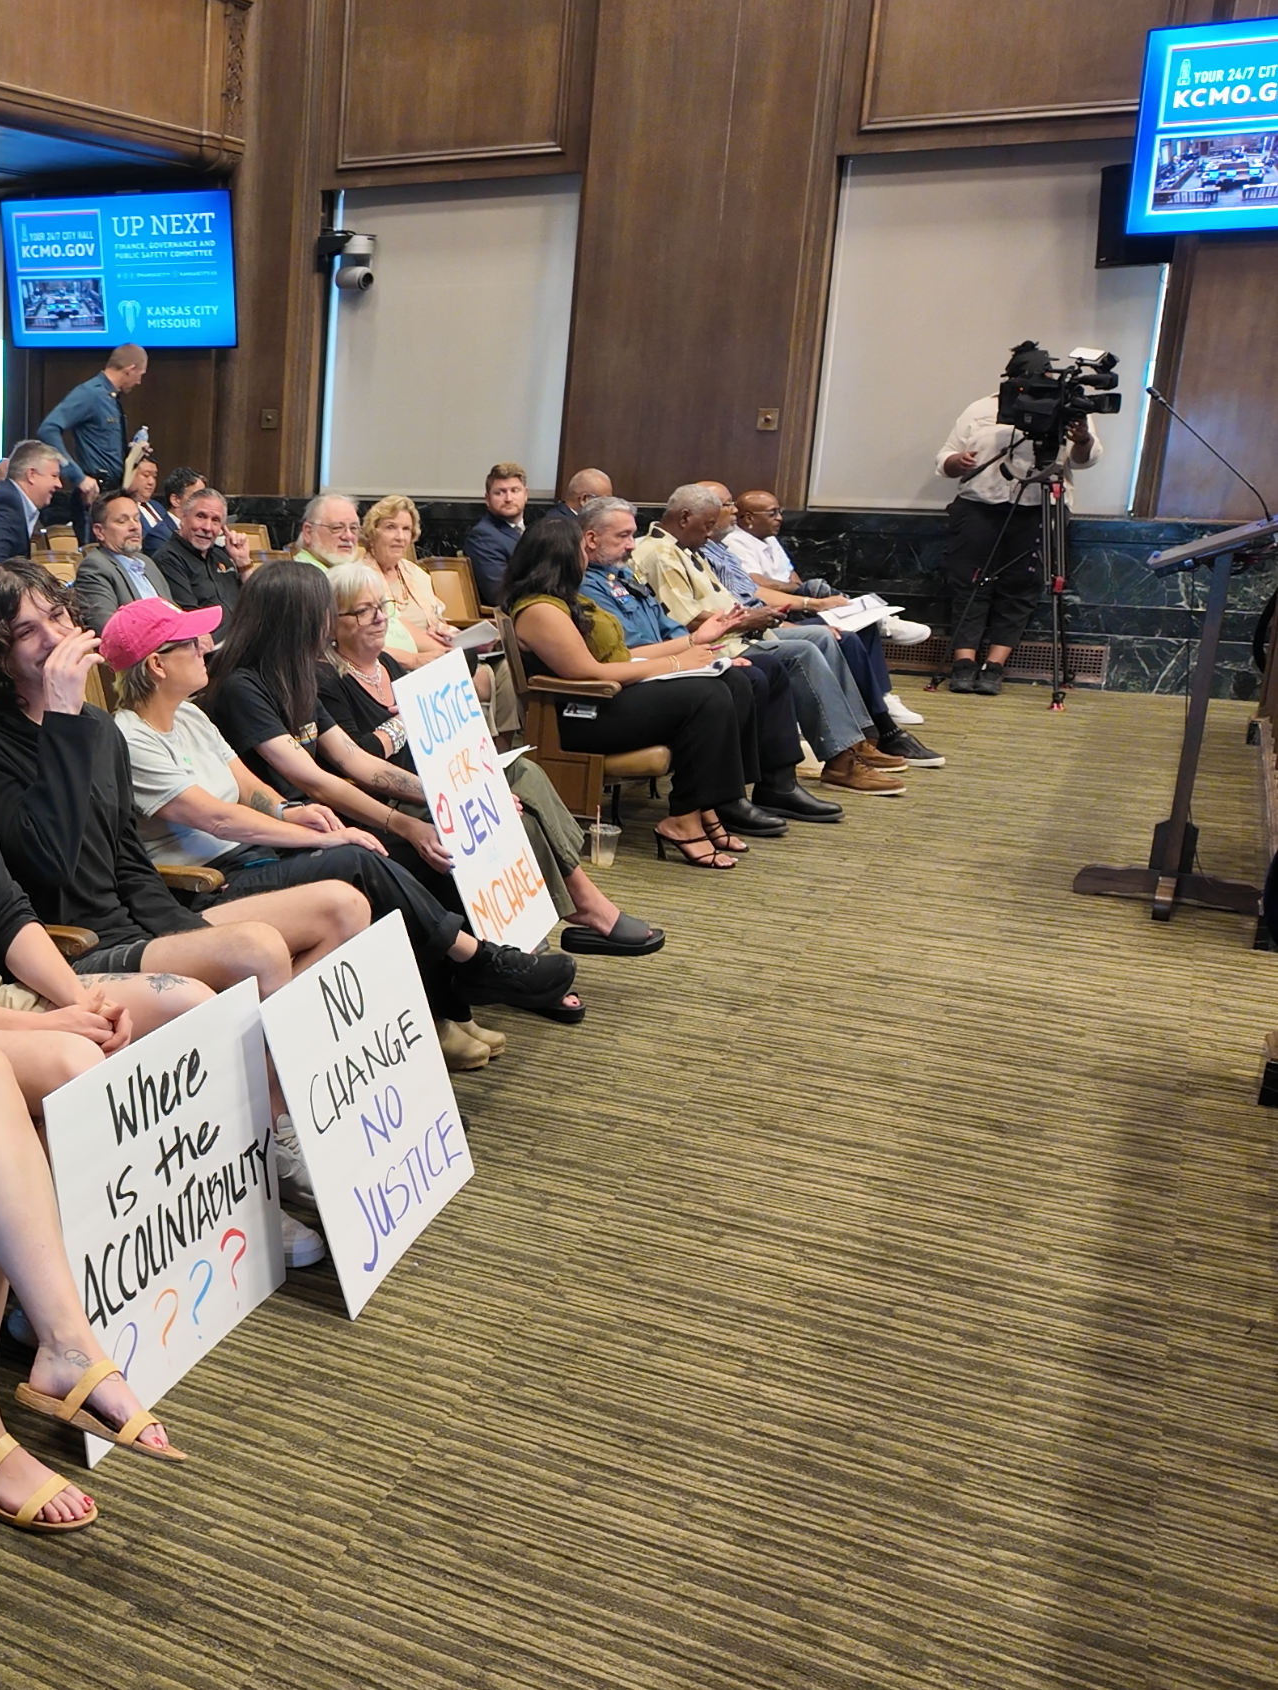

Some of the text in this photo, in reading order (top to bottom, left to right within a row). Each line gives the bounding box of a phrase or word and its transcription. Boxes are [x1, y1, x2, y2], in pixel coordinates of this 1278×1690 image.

[1193, 69, 1224, 84] YOUR
[1227, 66, 1256, 81] 24/7
[21, 243, 95, 259] KCMO.GOV
[29, 232, 46, 242] YOUR
[62, 231, 76, 240] CITY
[77, 230, 94, 240] HALL
[111, 212, 216, 237] UP NEXT
[141, 251, 168, 259] SAFETY
[170, 249, 214, 258] COMMITTEE
[148, 240, 198, 249] GOVERNANCE
[146, 304, 219, 317] KANSAS CITY
[147, 318, 202, 329] MISSOURI
[417, 679, 481, 756] JUSTICE
[448, 747, 479, 792] FOR
[459, 782, 501, 856] JEN
[471, 847, 545, 941] MICHAEL
[318, 960, 366, 1042] NO
[106, 1047, 208, 1148] Where
[309, 1009, 423, 1135] CHANGE
[154, 1120, 220, 1186] the
[360, 1085, 404, 1158] NO
[352, 1110, 463, 1273] JUSTICE
[84, 1127, 271, 1330] ACCOUNTABILITY
